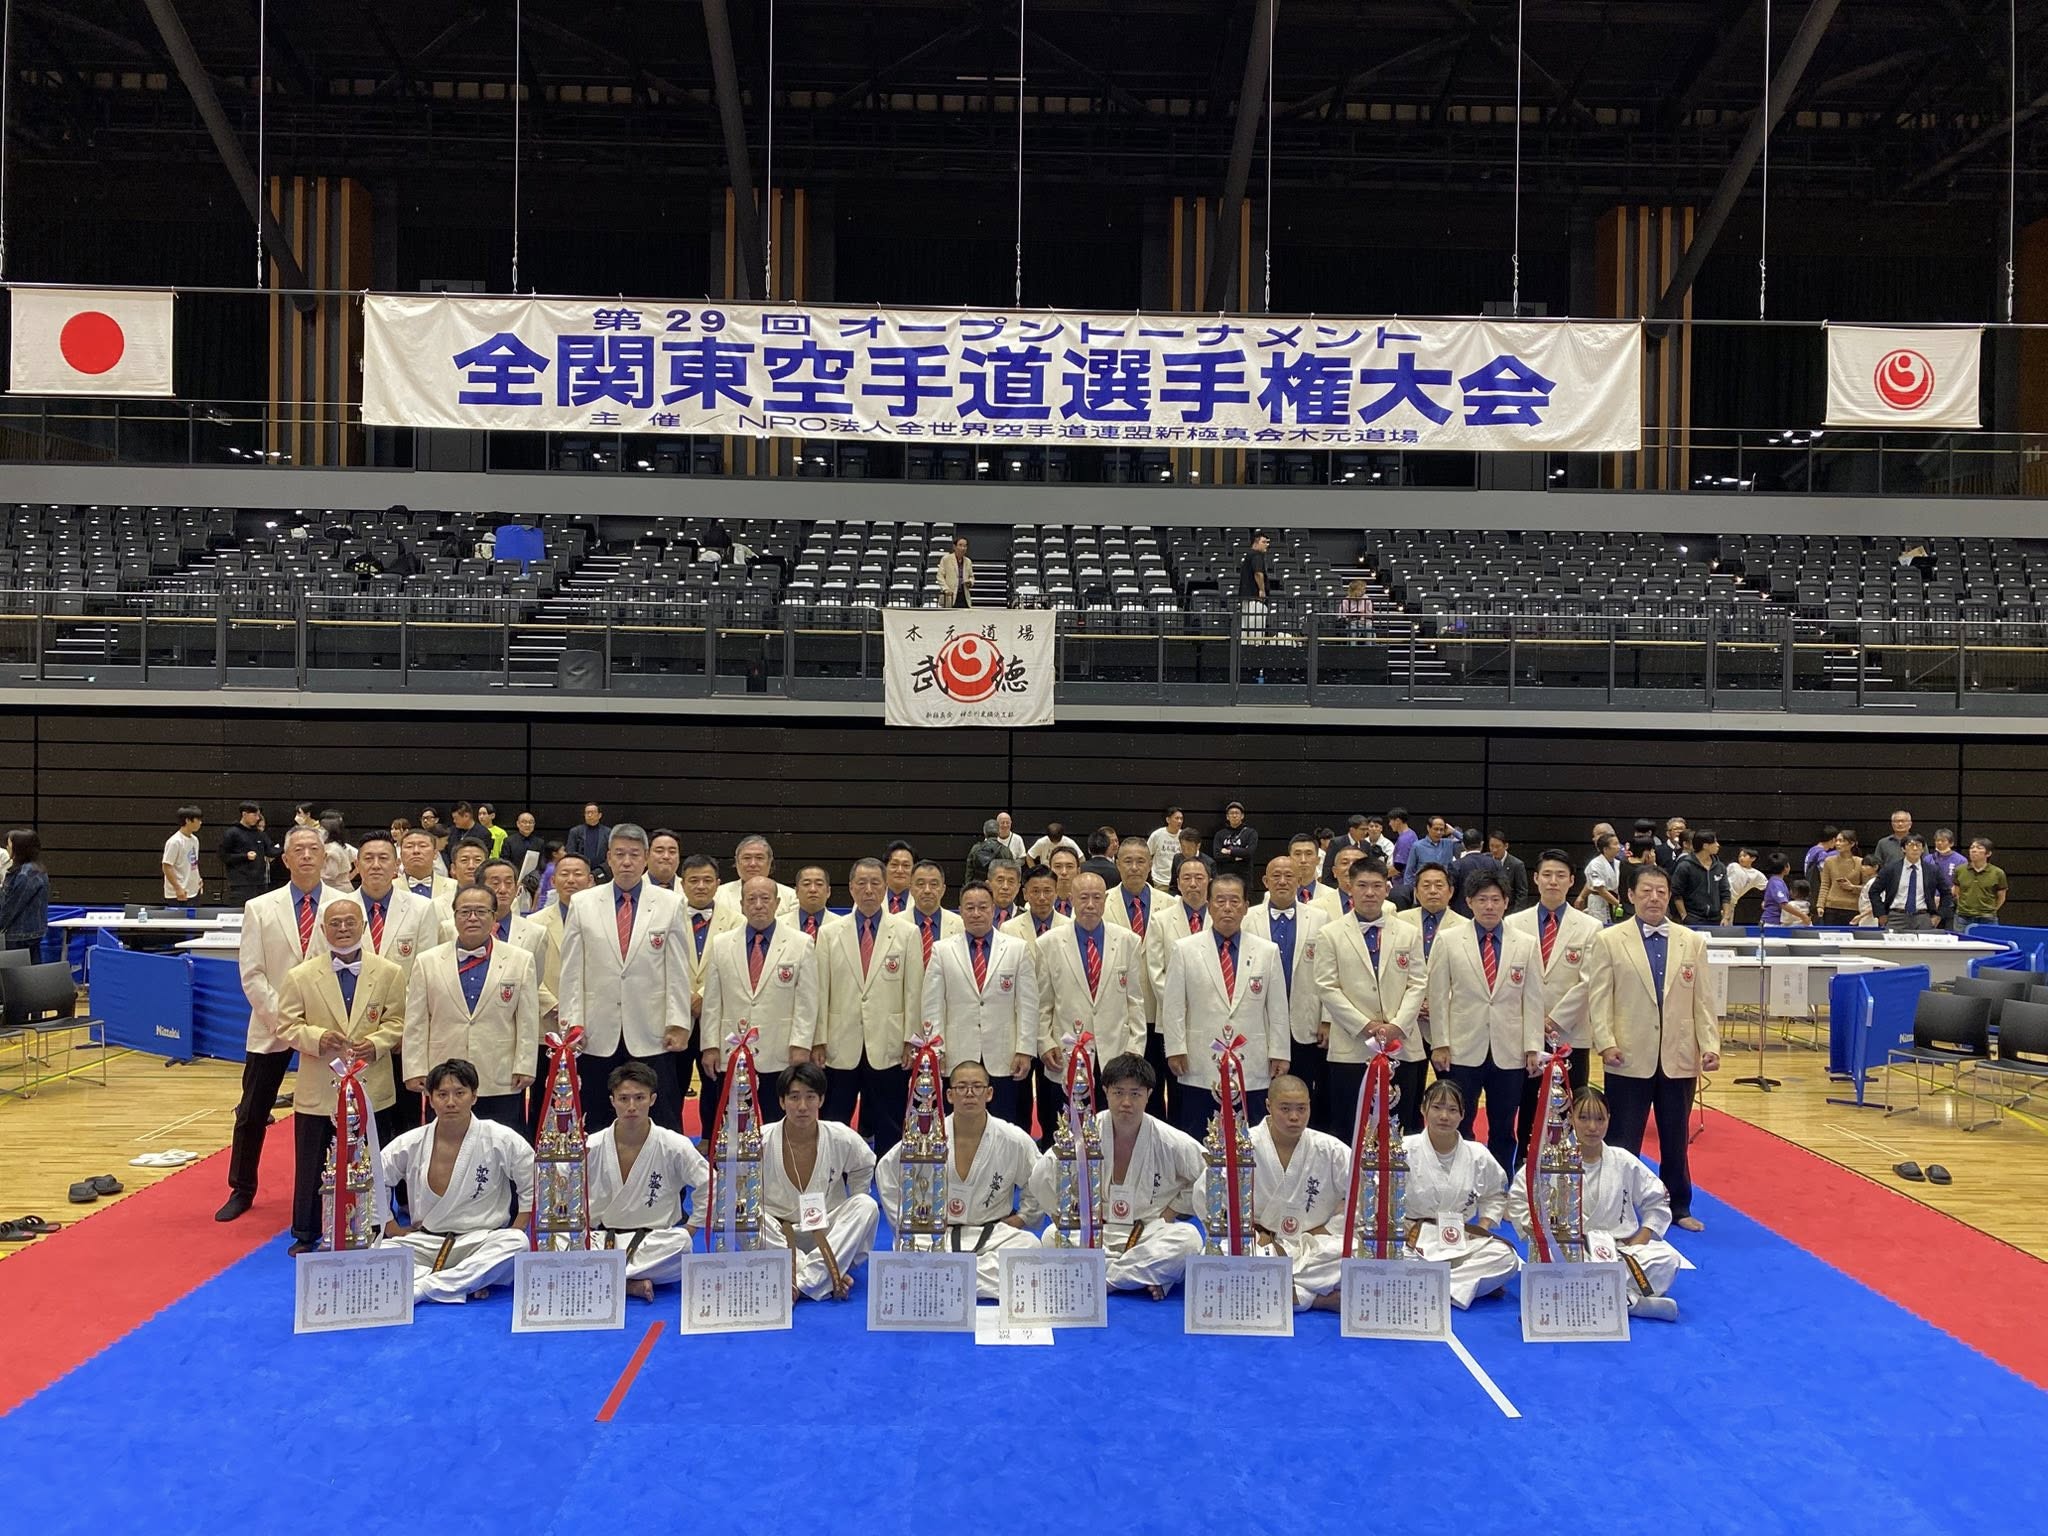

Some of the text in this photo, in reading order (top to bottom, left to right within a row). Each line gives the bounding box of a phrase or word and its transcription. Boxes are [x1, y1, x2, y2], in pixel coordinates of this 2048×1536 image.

[452, 332, 1557, 427] 全関東空手道選手権大会
